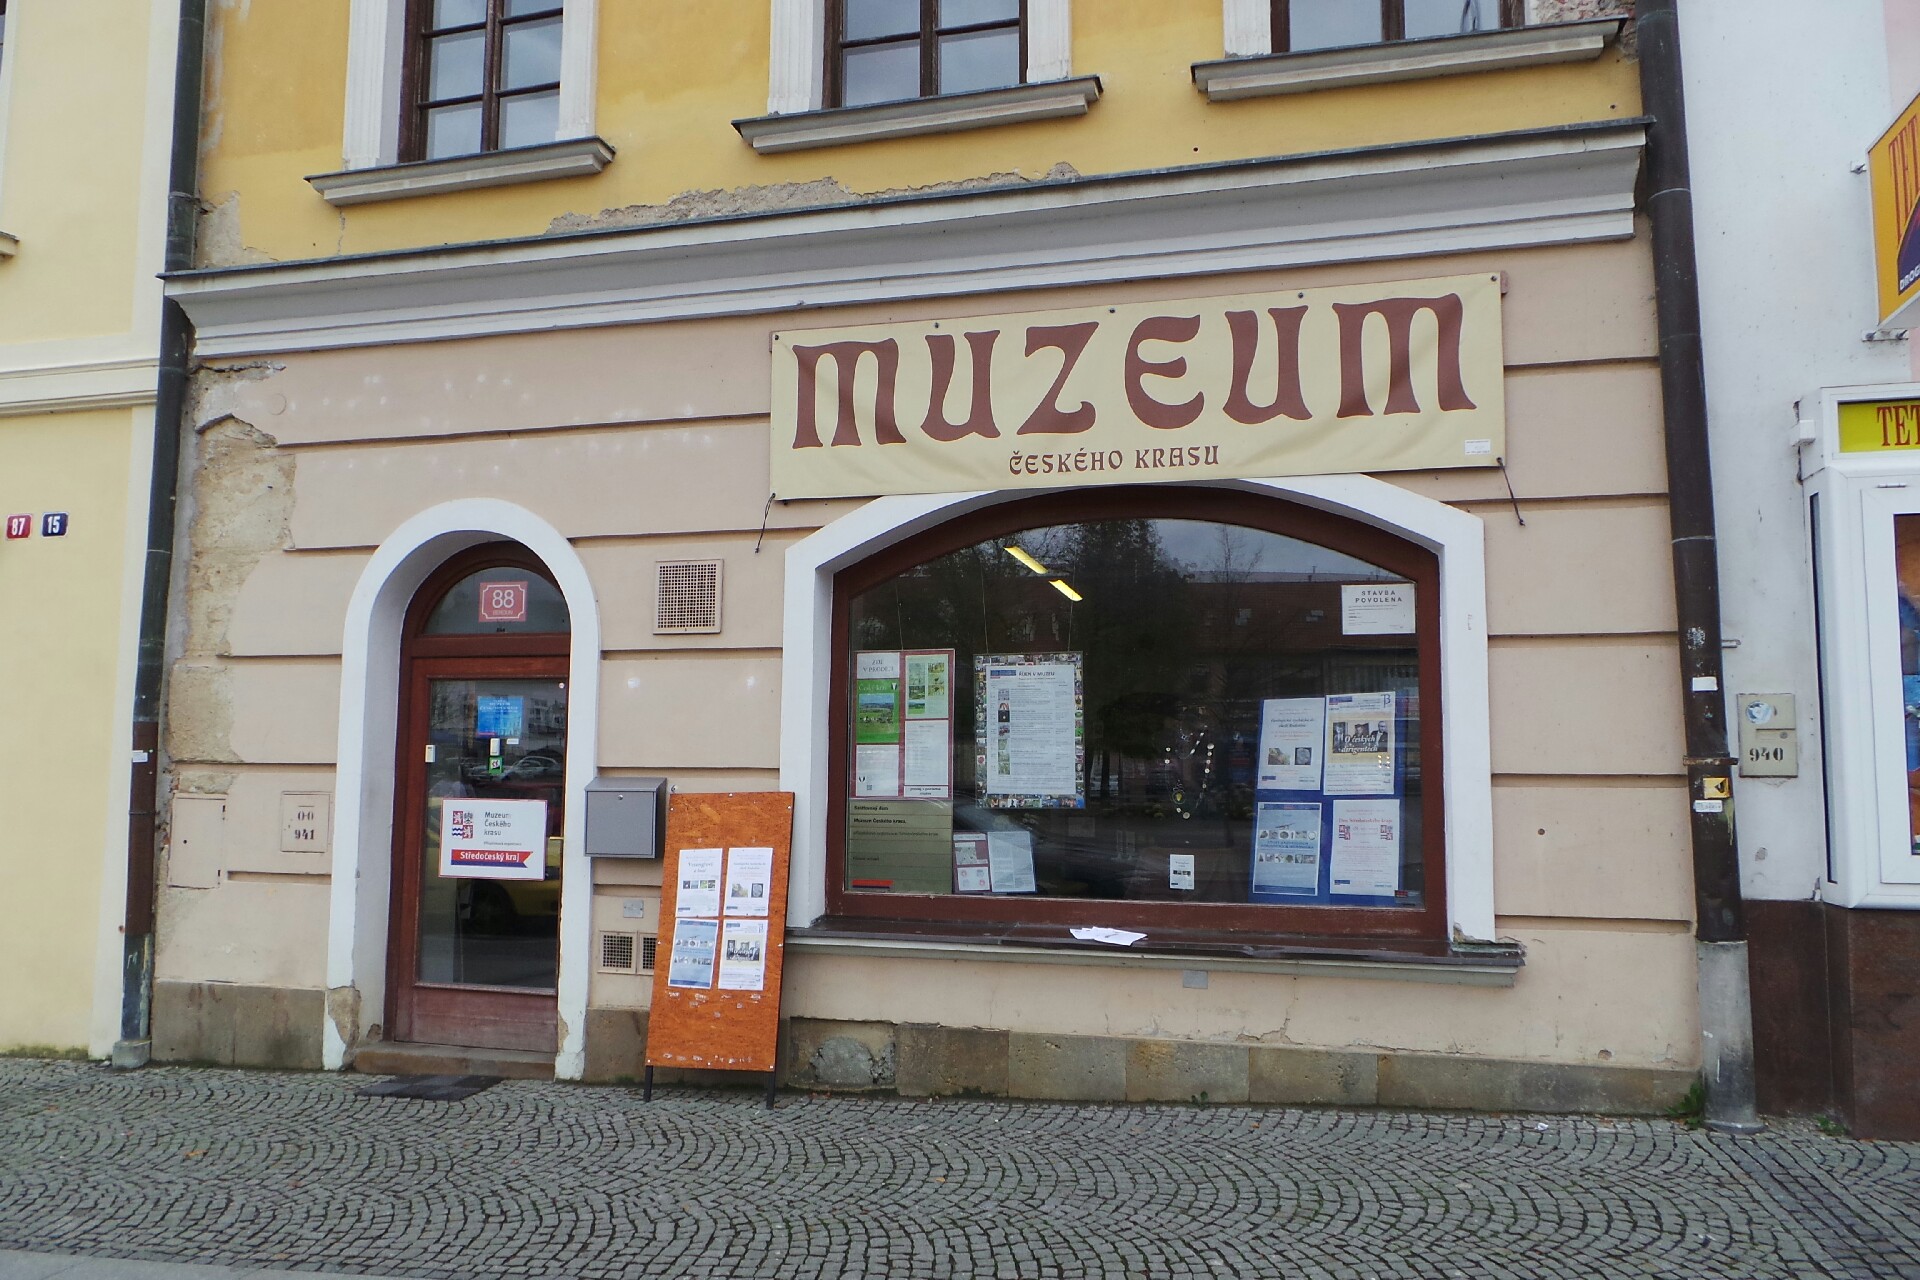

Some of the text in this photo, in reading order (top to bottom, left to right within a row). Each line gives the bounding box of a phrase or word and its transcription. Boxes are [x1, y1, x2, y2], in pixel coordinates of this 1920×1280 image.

[792, 293, 1478, 449] MUZEUM
[1008, 444, 1220, 476] ČESKÉHO KRASU
[12, 518, 25, 536] 87
[48, 516, 60, 534] 15
[492, 589, 514, 608] 88
[1749, 747, 1784, 762] 940
[484, 820, 512, 828] Českého
[294, 829, 315, 840] 941
[460, 851, 520, 863] Středočeský kraj
